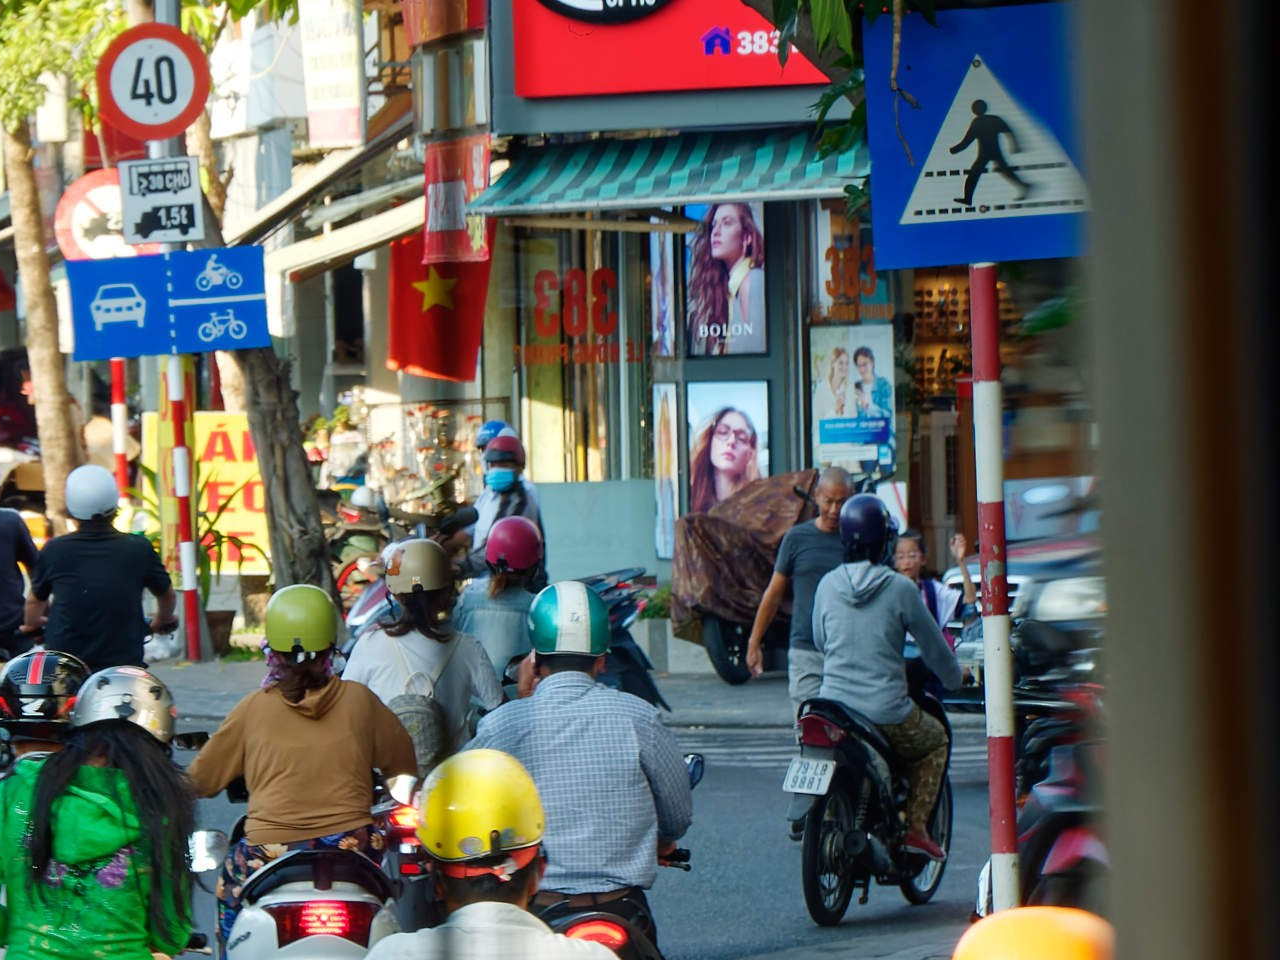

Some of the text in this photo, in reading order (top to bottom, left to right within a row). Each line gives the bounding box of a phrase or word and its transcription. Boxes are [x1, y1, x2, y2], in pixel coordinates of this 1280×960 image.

[130, 55, 177, 106] 40
[158, 207, 188, 228] 1,5t
[825, 245, 877, 297] 383
[699, 323, 753, 338] BOLON
